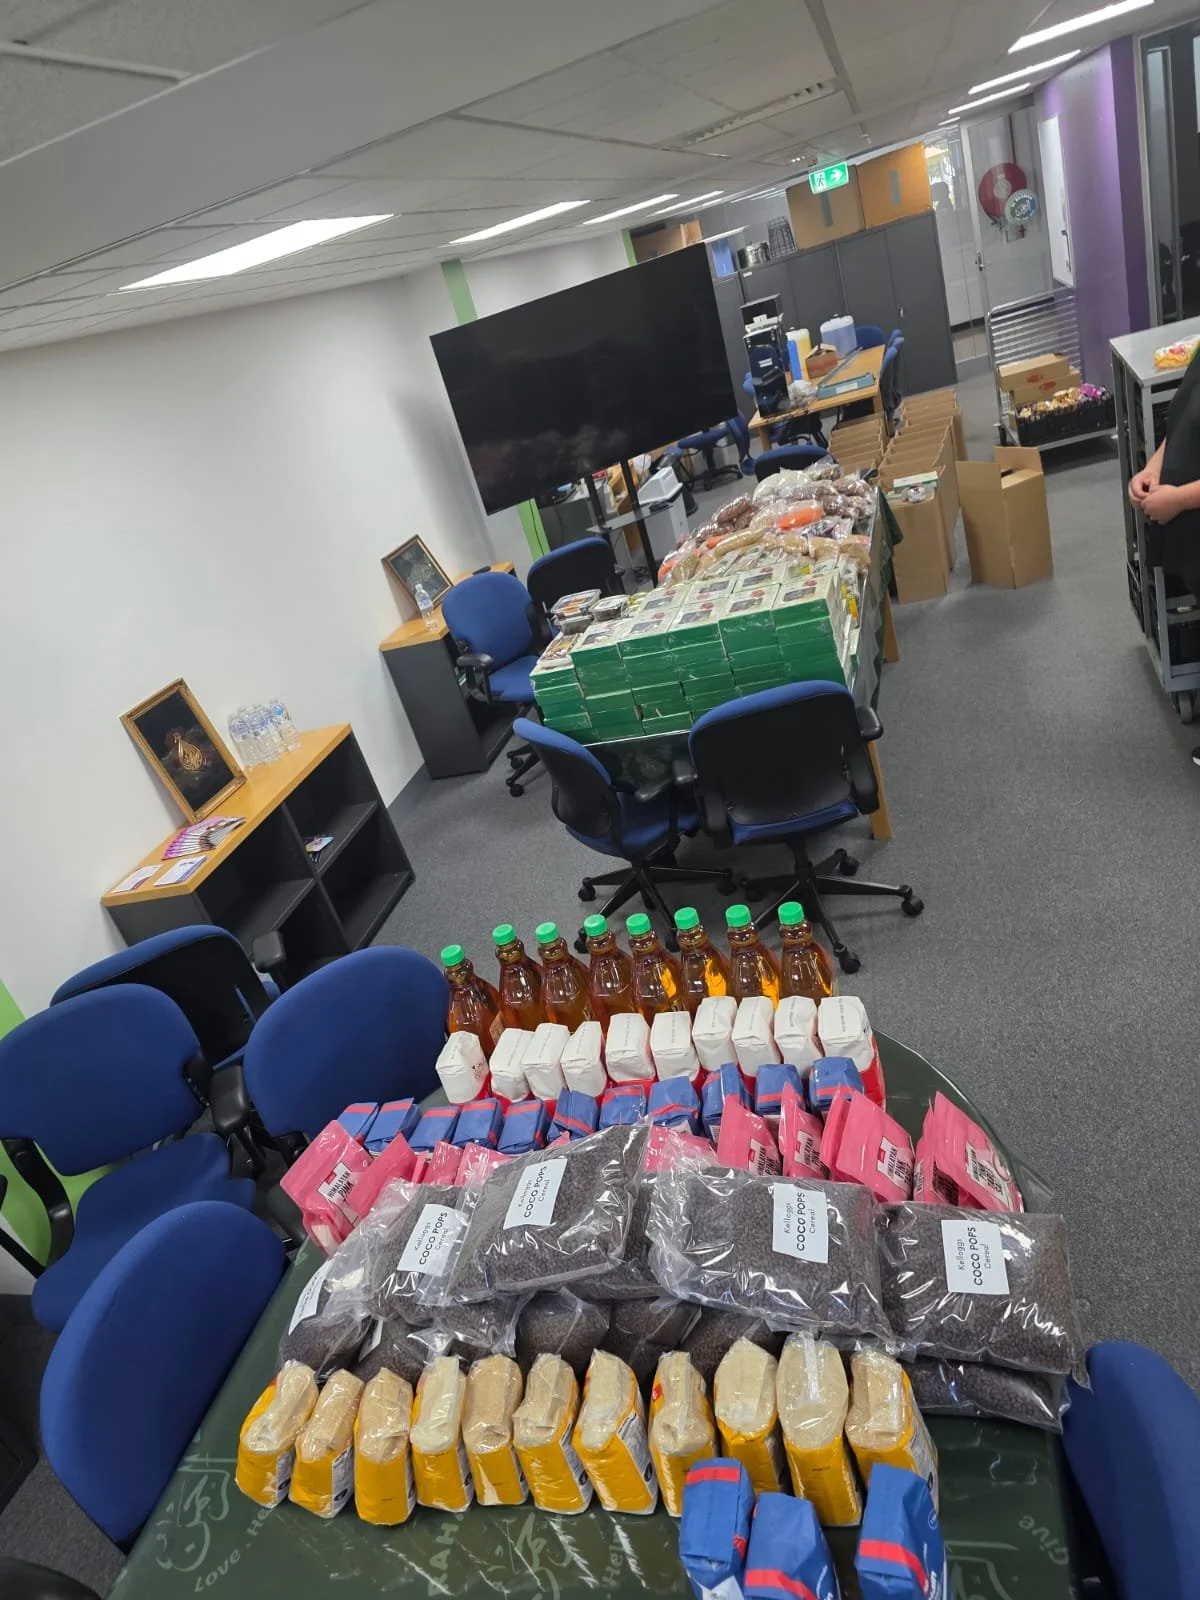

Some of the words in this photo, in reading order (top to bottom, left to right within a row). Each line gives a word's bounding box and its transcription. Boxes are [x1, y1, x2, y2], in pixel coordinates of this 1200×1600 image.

[524, 1189, 538, 1218] COCO
[534, 1166, 547, 1188] POPS
[538, 1179, 550, 1201] Cereal
[797, 1192, 806, 1216] POPS
[784, 1202, 793, 1234] Kelloggs
[796, 1217, 806, 1251] COCO
[808, 1208, 816, 1234] Cereal
[419, 1236, 436, 1265] COCO
[431, 1212, 448, 1234] POPS
[435, 1228, 449, 1251] Cereal
[956, 1238, 965, 1271] Kelloggs
[967, 1226, 978, 1251] POPS
[970, 1253, 983, 1286] COCO
[980, 1243, 991, 1269] Cereal
[195, 1549, 240, 1593] Love
[246, 1508, 271, 1537] He
[1018, 1515, 1069, 1566] Give
